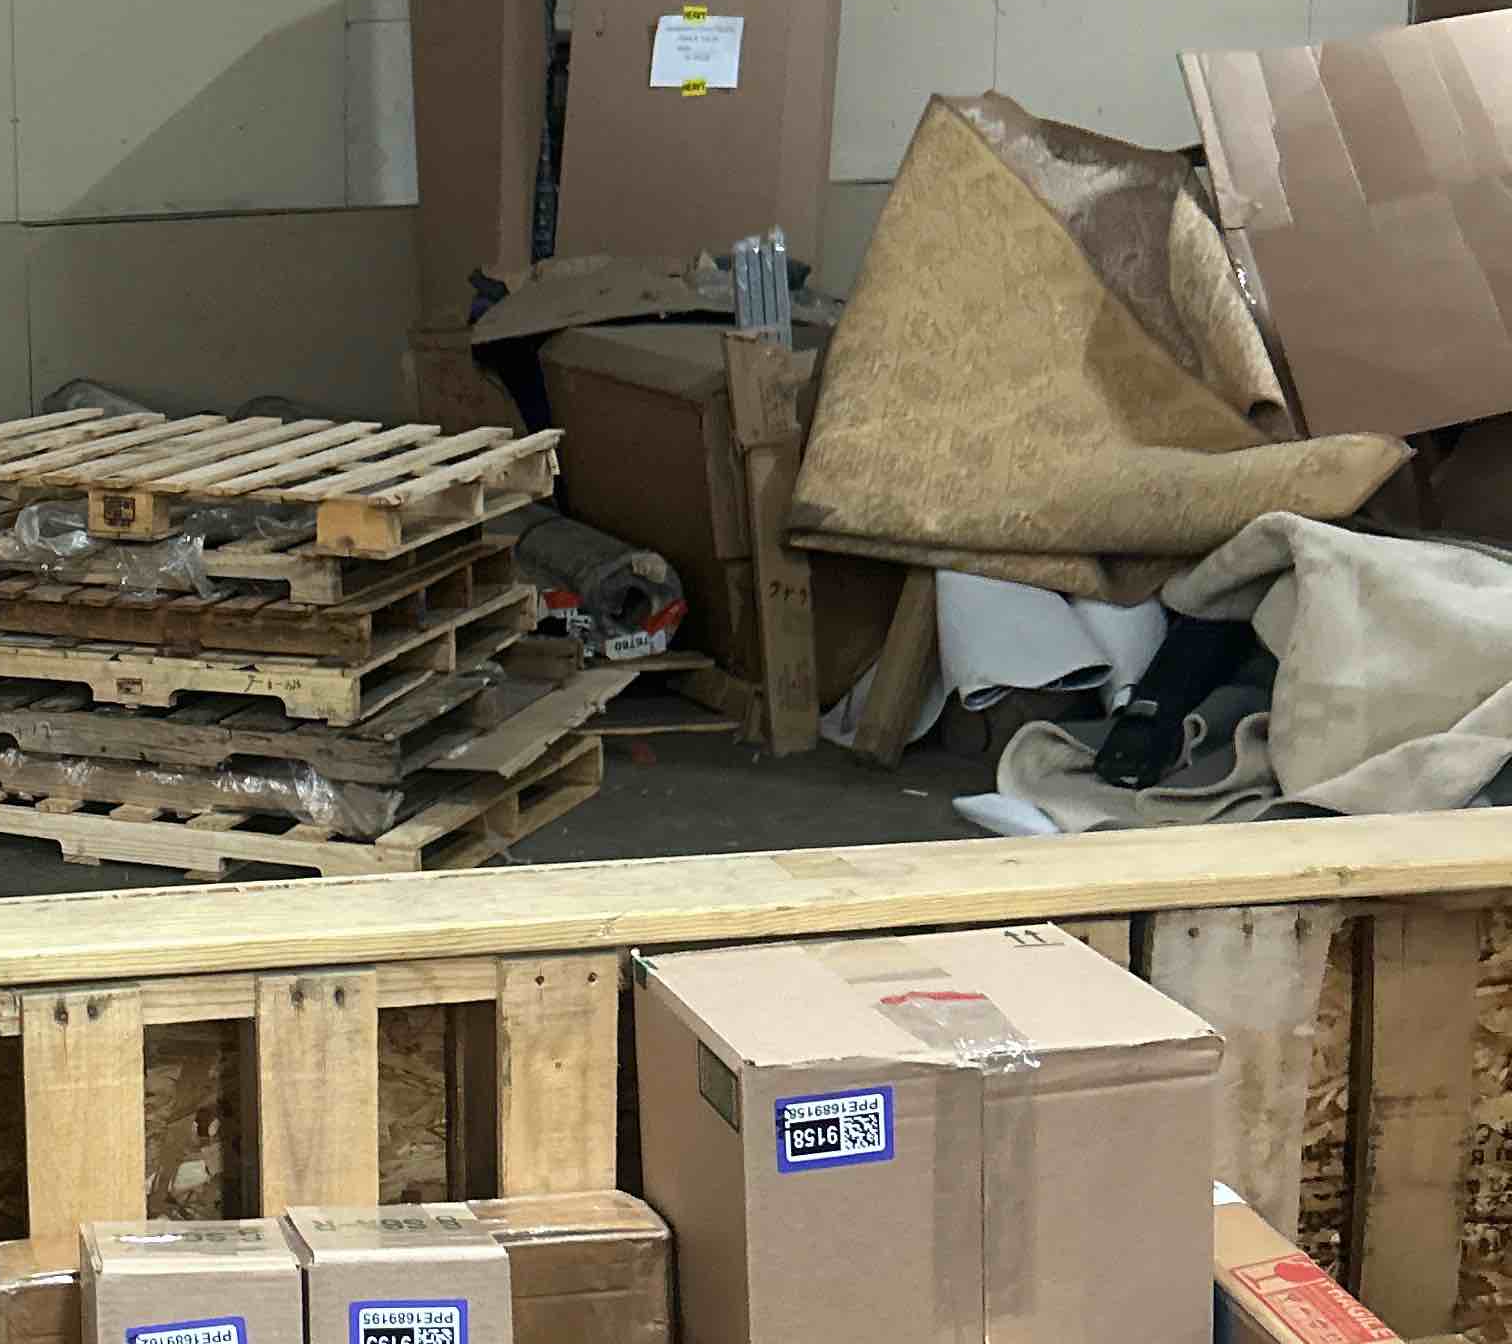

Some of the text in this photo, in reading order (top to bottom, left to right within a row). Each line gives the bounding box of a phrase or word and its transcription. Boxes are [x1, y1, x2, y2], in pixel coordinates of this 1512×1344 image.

[789, 1098, 878, 1119] PPE1689158
[792, 1125, 839, 1149] 9158
[363, 1311, 454, 1325] PPE1689195
